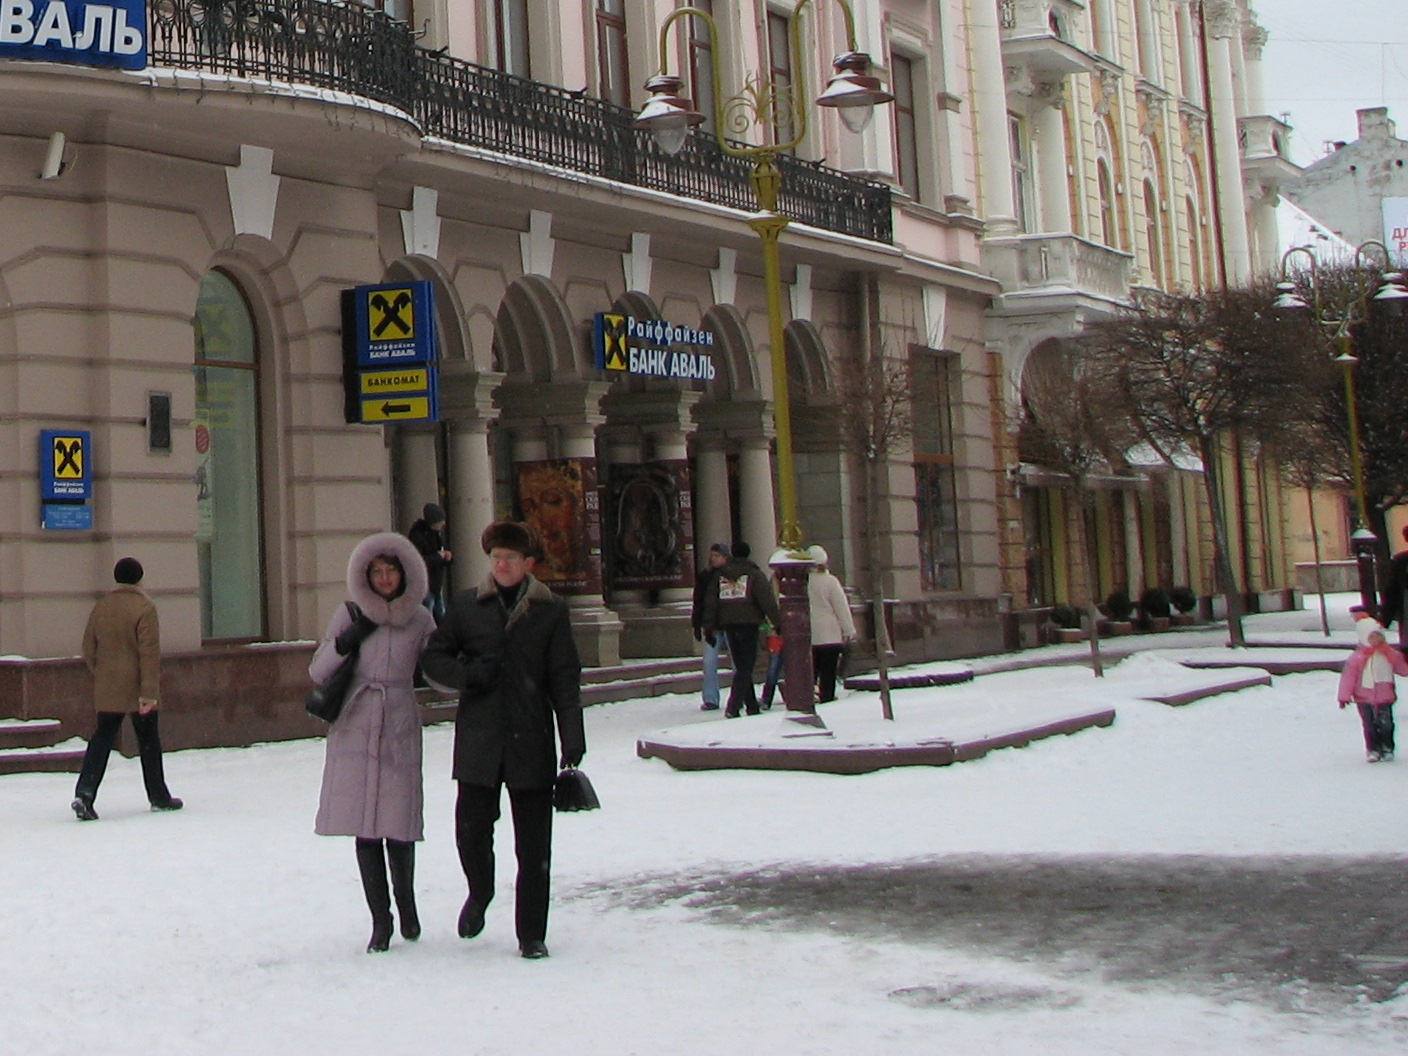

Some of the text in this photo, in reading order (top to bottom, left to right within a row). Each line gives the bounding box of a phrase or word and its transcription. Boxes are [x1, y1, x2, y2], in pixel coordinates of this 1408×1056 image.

[628, 316, 714, 347] Райффайзен
[629, 347, 716, 380] БАНК АВАЛЬ
[368, 375, 419, 386] БАНКОМАТ
